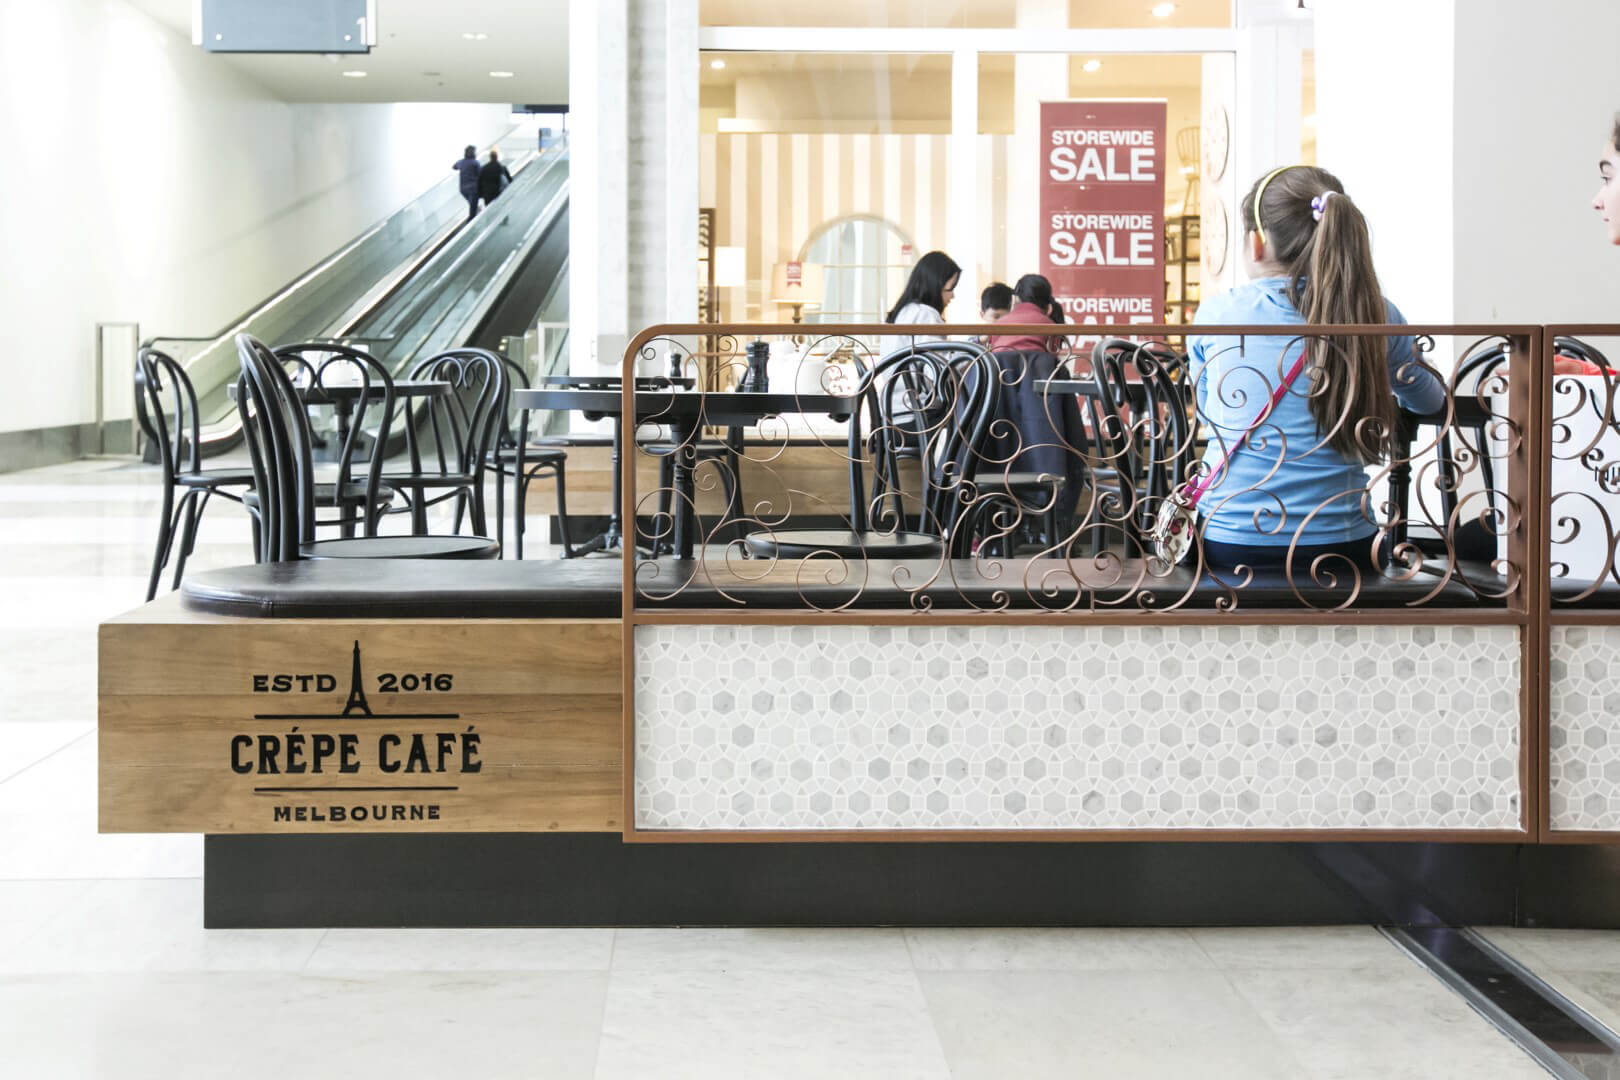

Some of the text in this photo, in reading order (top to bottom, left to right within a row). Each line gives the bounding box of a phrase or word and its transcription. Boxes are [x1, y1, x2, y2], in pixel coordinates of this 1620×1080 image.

[1051, 129, 1154, 146] STOREWIDE
[1049, 147, 1156, 182] SALE
[1051, 214, 1153, 230] STOREWIDE
[1049, 232, 1155, 266] SALE
[253, 673, 454, 693] ESTD 2016
[378, 725, 483, 774] CAFÉ
[273, 804, 441, 822] MELBOURNE
